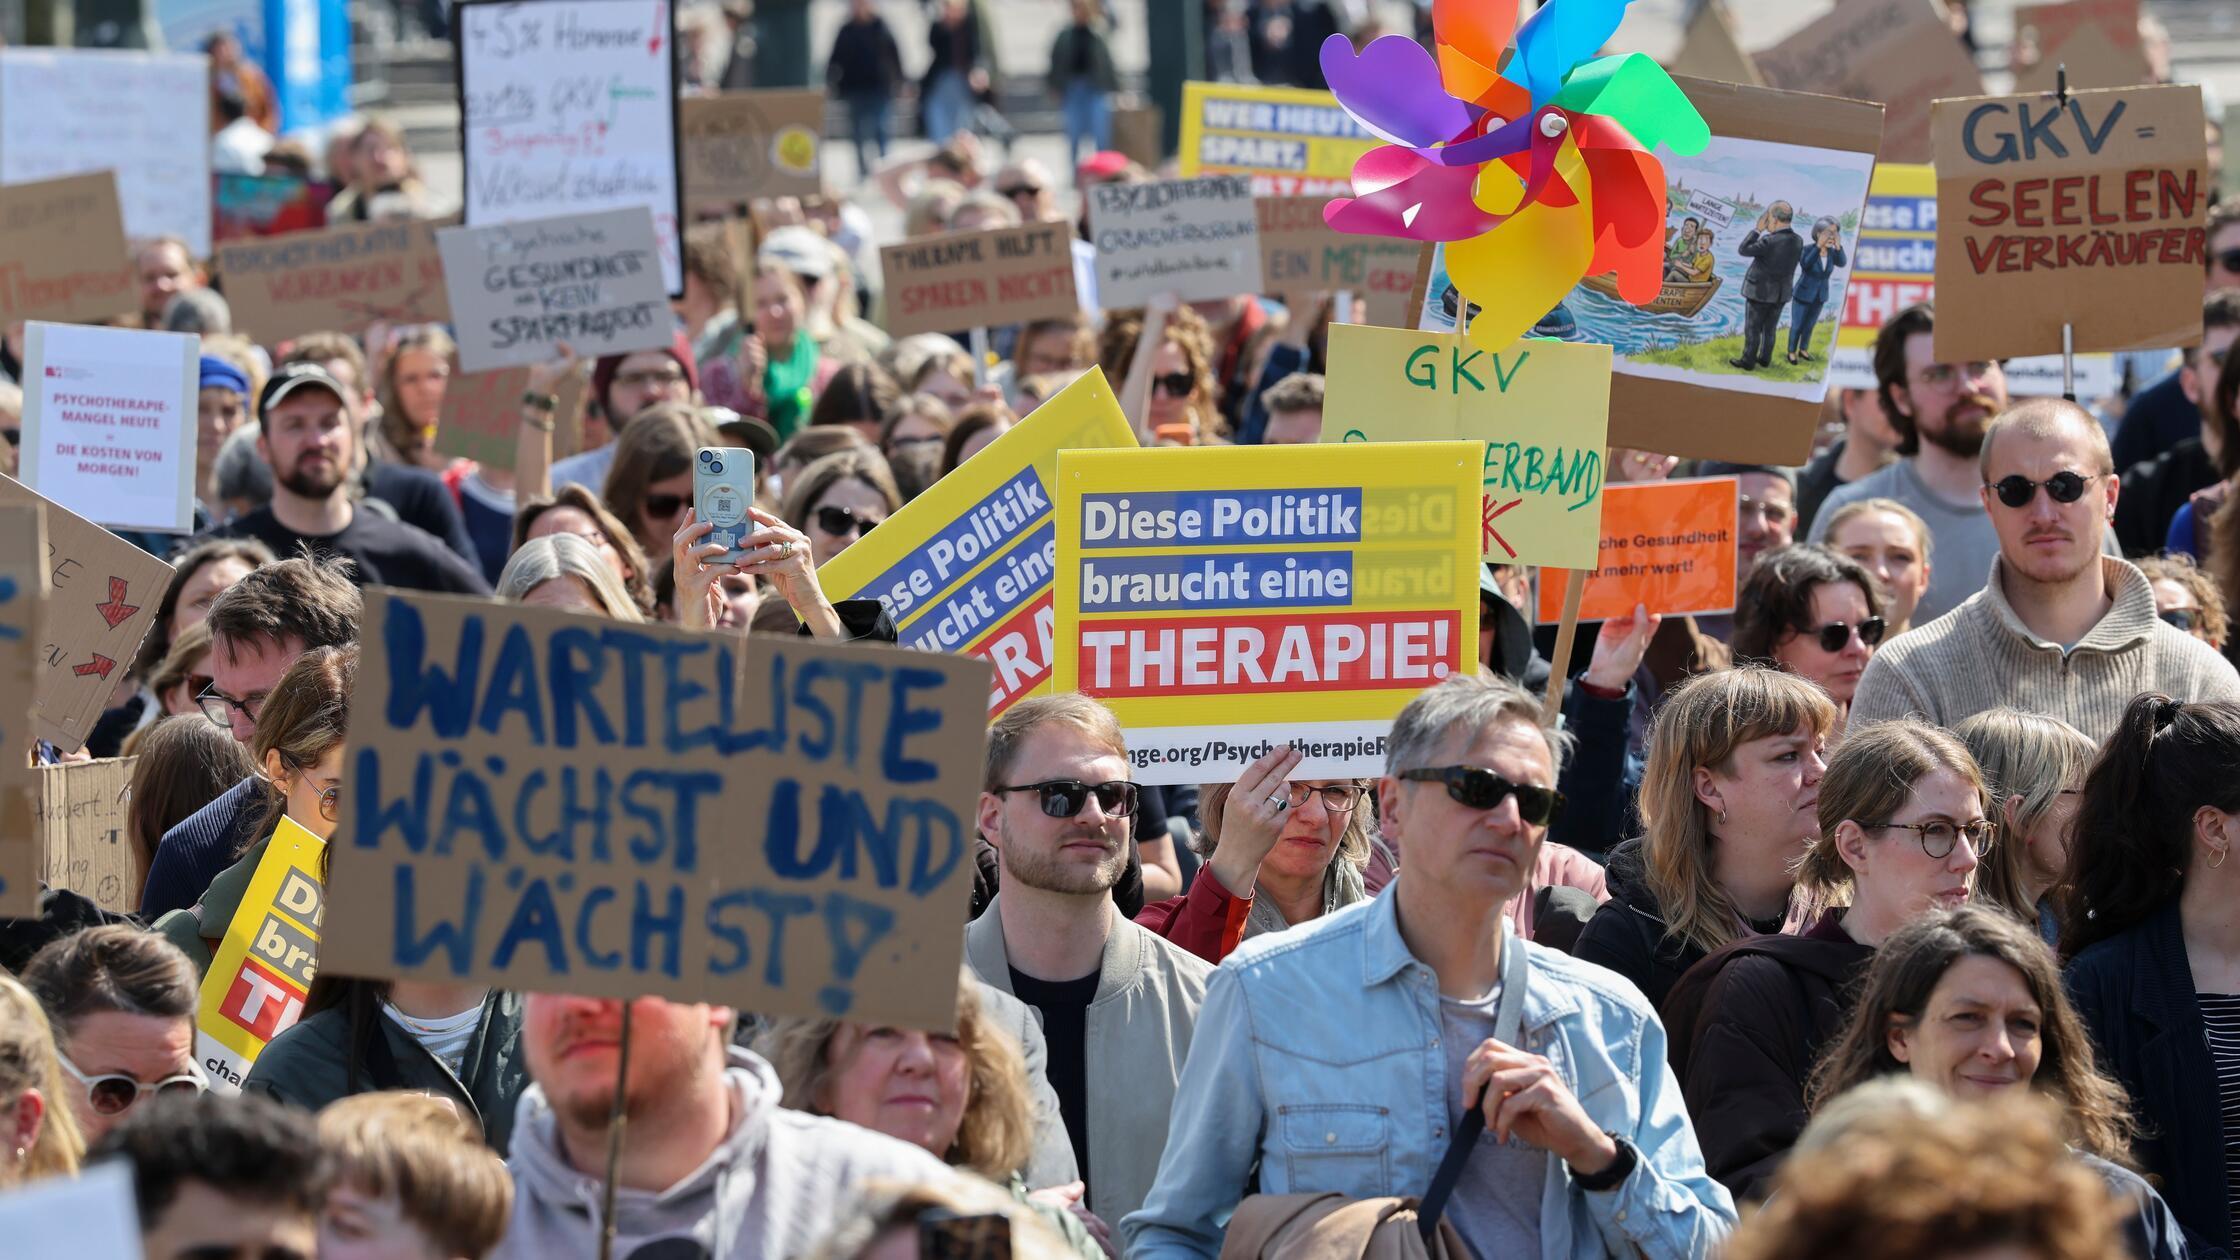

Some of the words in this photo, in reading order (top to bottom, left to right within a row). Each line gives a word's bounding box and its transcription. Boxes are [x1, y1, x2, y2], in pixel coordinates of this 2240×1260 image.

[1204, 100, 1274, 131] WER
[1962, 98, 2127, 165] GKV
[2135, 126, 2155, 138] =
[1201, 136, 1306, 172] SPART.
[1968, 169, 2205, 227] SEELEN-
[484, 250, 648, 292] GESUNDHEIT
[892, 238, 984, 273] THERAPIE
[994, 229, 1055, 260] HILFT
[1963, 226, 2206, 275] VERKÄUFER
[902, 276, 989, 315] SPAREN
[1404, 344, 1530, 394] GKV
[53, 393, 170, 413] PSYCHOTHERAPIE-
[62, 410, 117, 427] MANGEL
[120, 415, 161, 430] HEUTE
[56, 443, 77, 457] DIE
[81, 445, 132, 460] KOSTEN
[134, 449, 163, 463] VON
[77, 462, 139, 477] MORGEN!
[1084, 499, 1201, 541] Diese
[1212, 493, 1358, 538] Politik
[1599, 536, 1628, 551] che
[1633, 529, 1729, 549] Gesundheit
[880, 568, 934, 621] ese
[927, 480, 1049, 582] Politik
[1604, 563, 1648, 577] mehr
[1651, 559, 1694, 575] wert!
[1083, 559, 1250, 605] braucht
[1259, 557, 1349, 599] eine
[1081, 620, 1451, 690] THERAPIE!
[384, 596, 949, 784] WARTELISTE
[353, 746, 726, 874] WÄCHST
[764, 778, 966, 897] UND
[392, 862, 897, 1014] WÄCHST!
